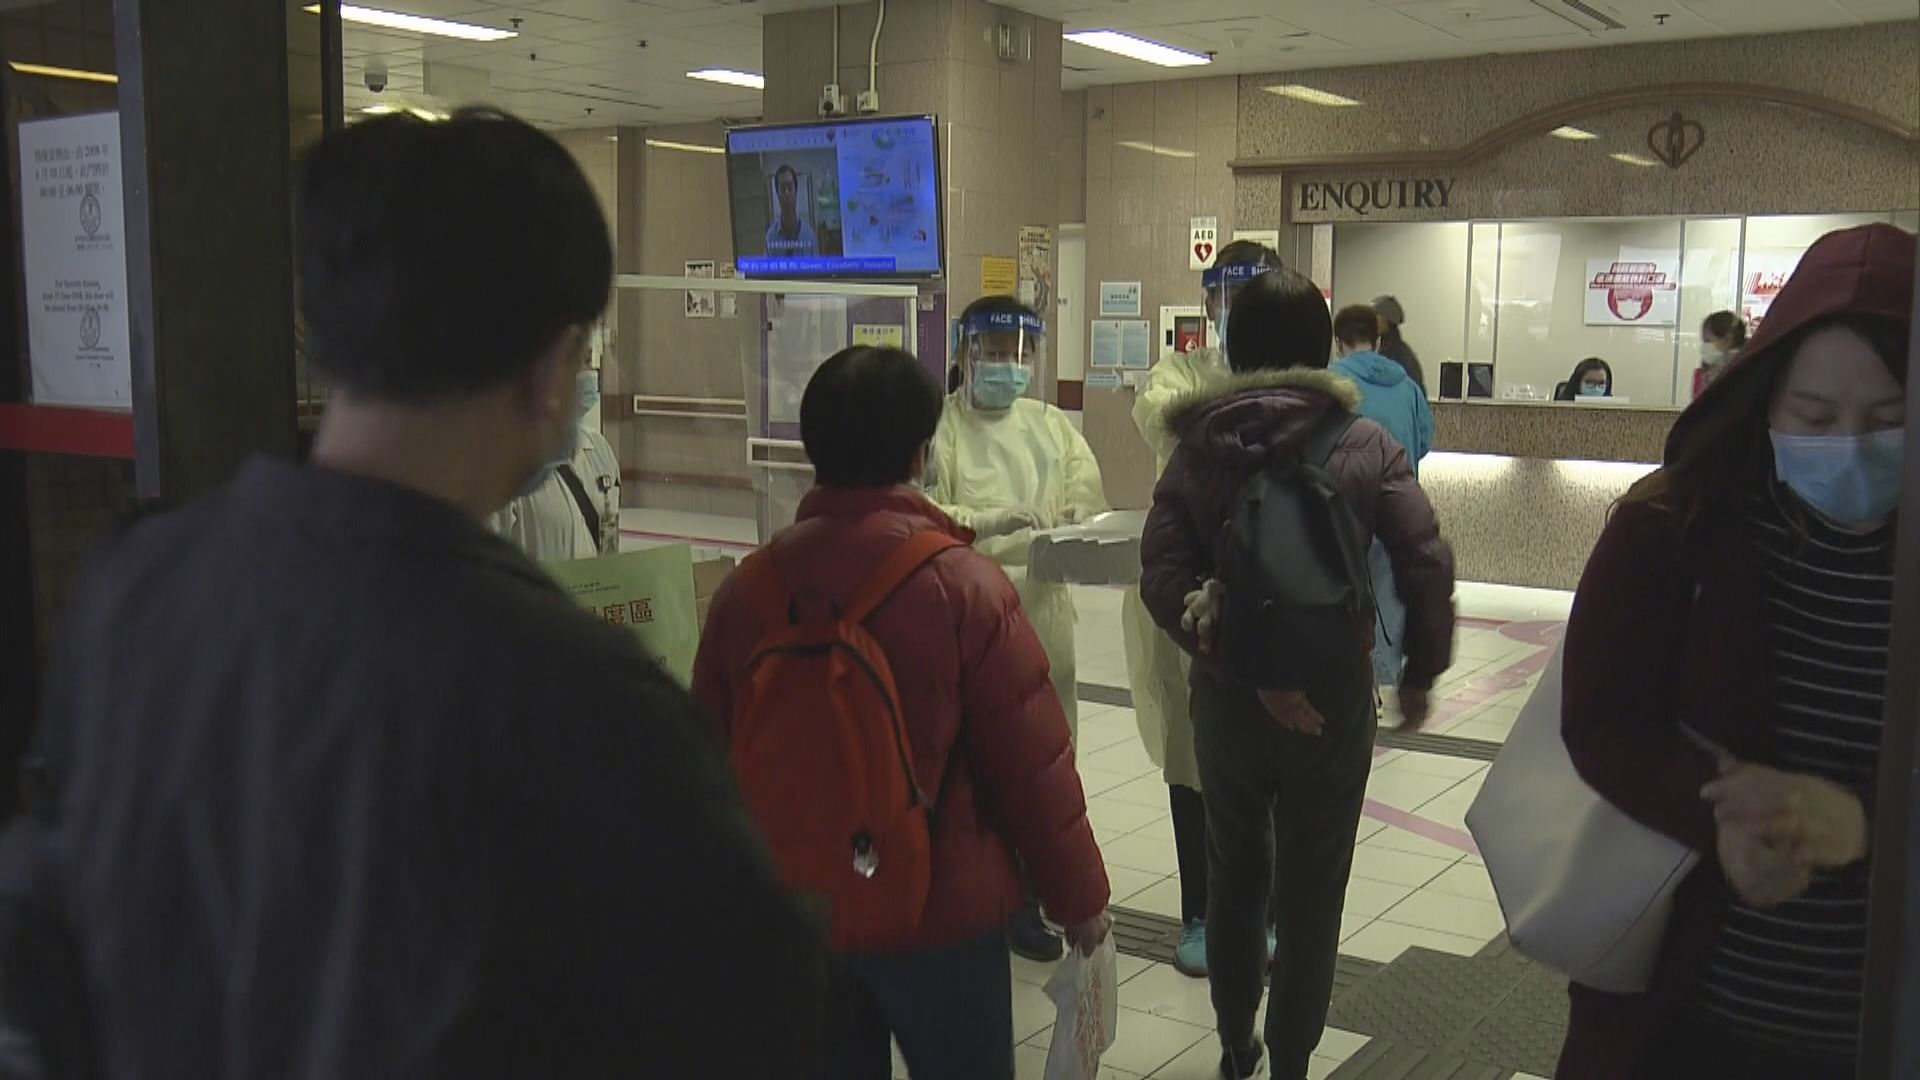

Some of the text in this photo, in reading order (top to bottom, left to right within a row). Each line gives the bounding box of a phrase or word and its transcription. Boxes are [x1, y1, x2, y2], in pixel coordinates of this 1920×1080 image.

[1301, 178, 1455, 215] ENQUIRY
[1194, 230, 1214, 240] AED
[800, 262, 822, 270] Queen
[1223, 266, 1245, 276] FACE
[990, 313, 1012, 323] FACE
[591, 598, 655, 624] 度區
